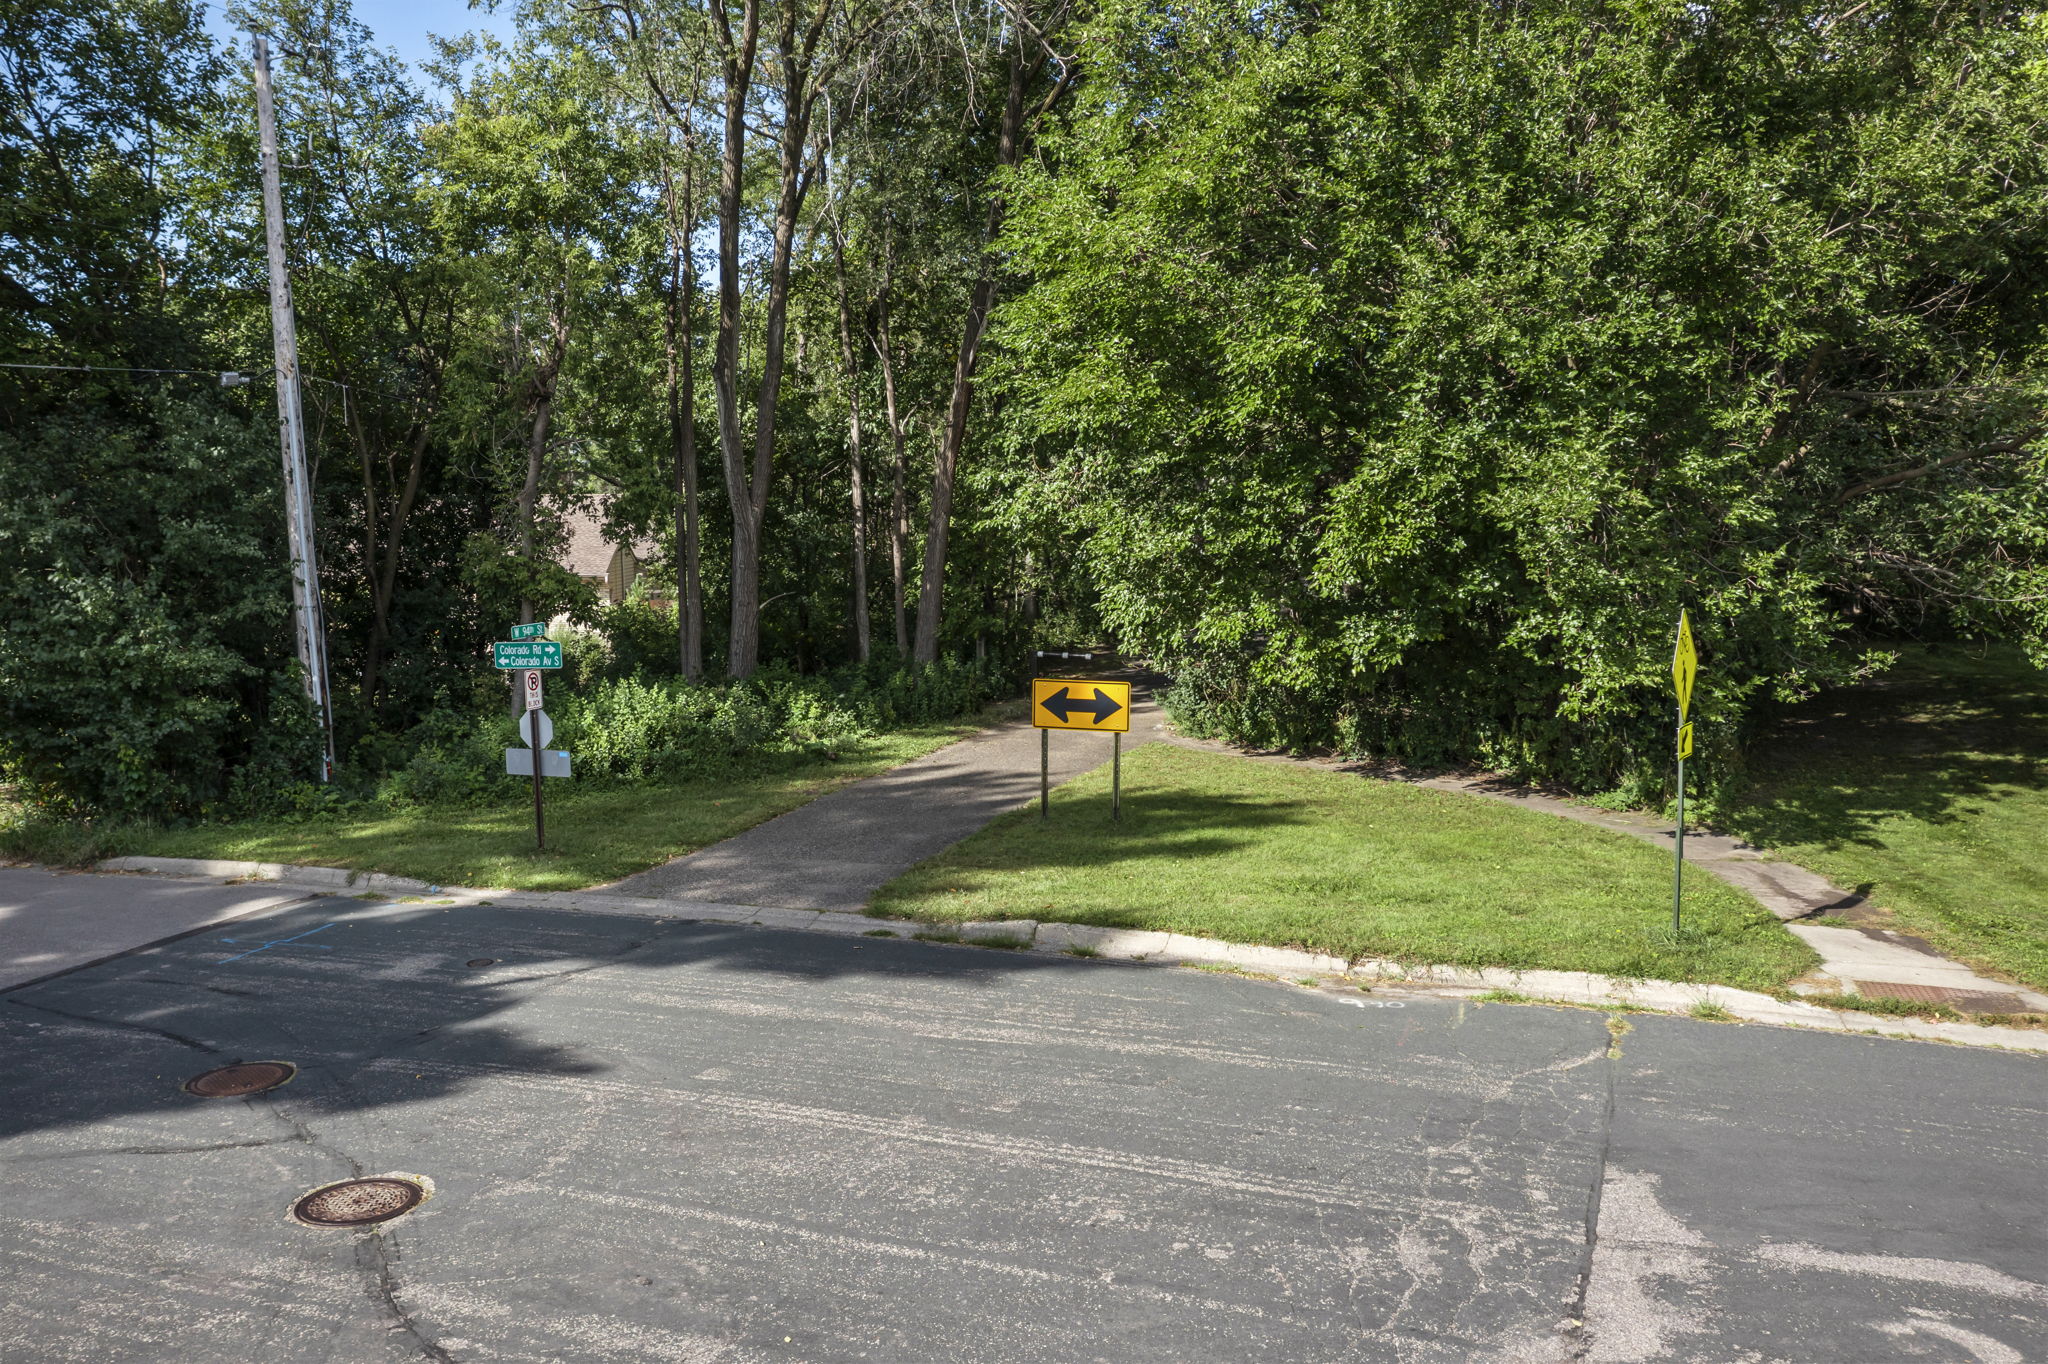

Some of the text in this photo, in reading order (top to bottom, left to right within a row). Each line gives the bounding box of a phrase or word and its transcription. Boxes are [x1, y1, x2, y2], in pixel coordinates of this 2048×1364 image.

[499, 645, 542, 655] Colorado Rd
[510, 656, 559, 666] Colorado Av S
